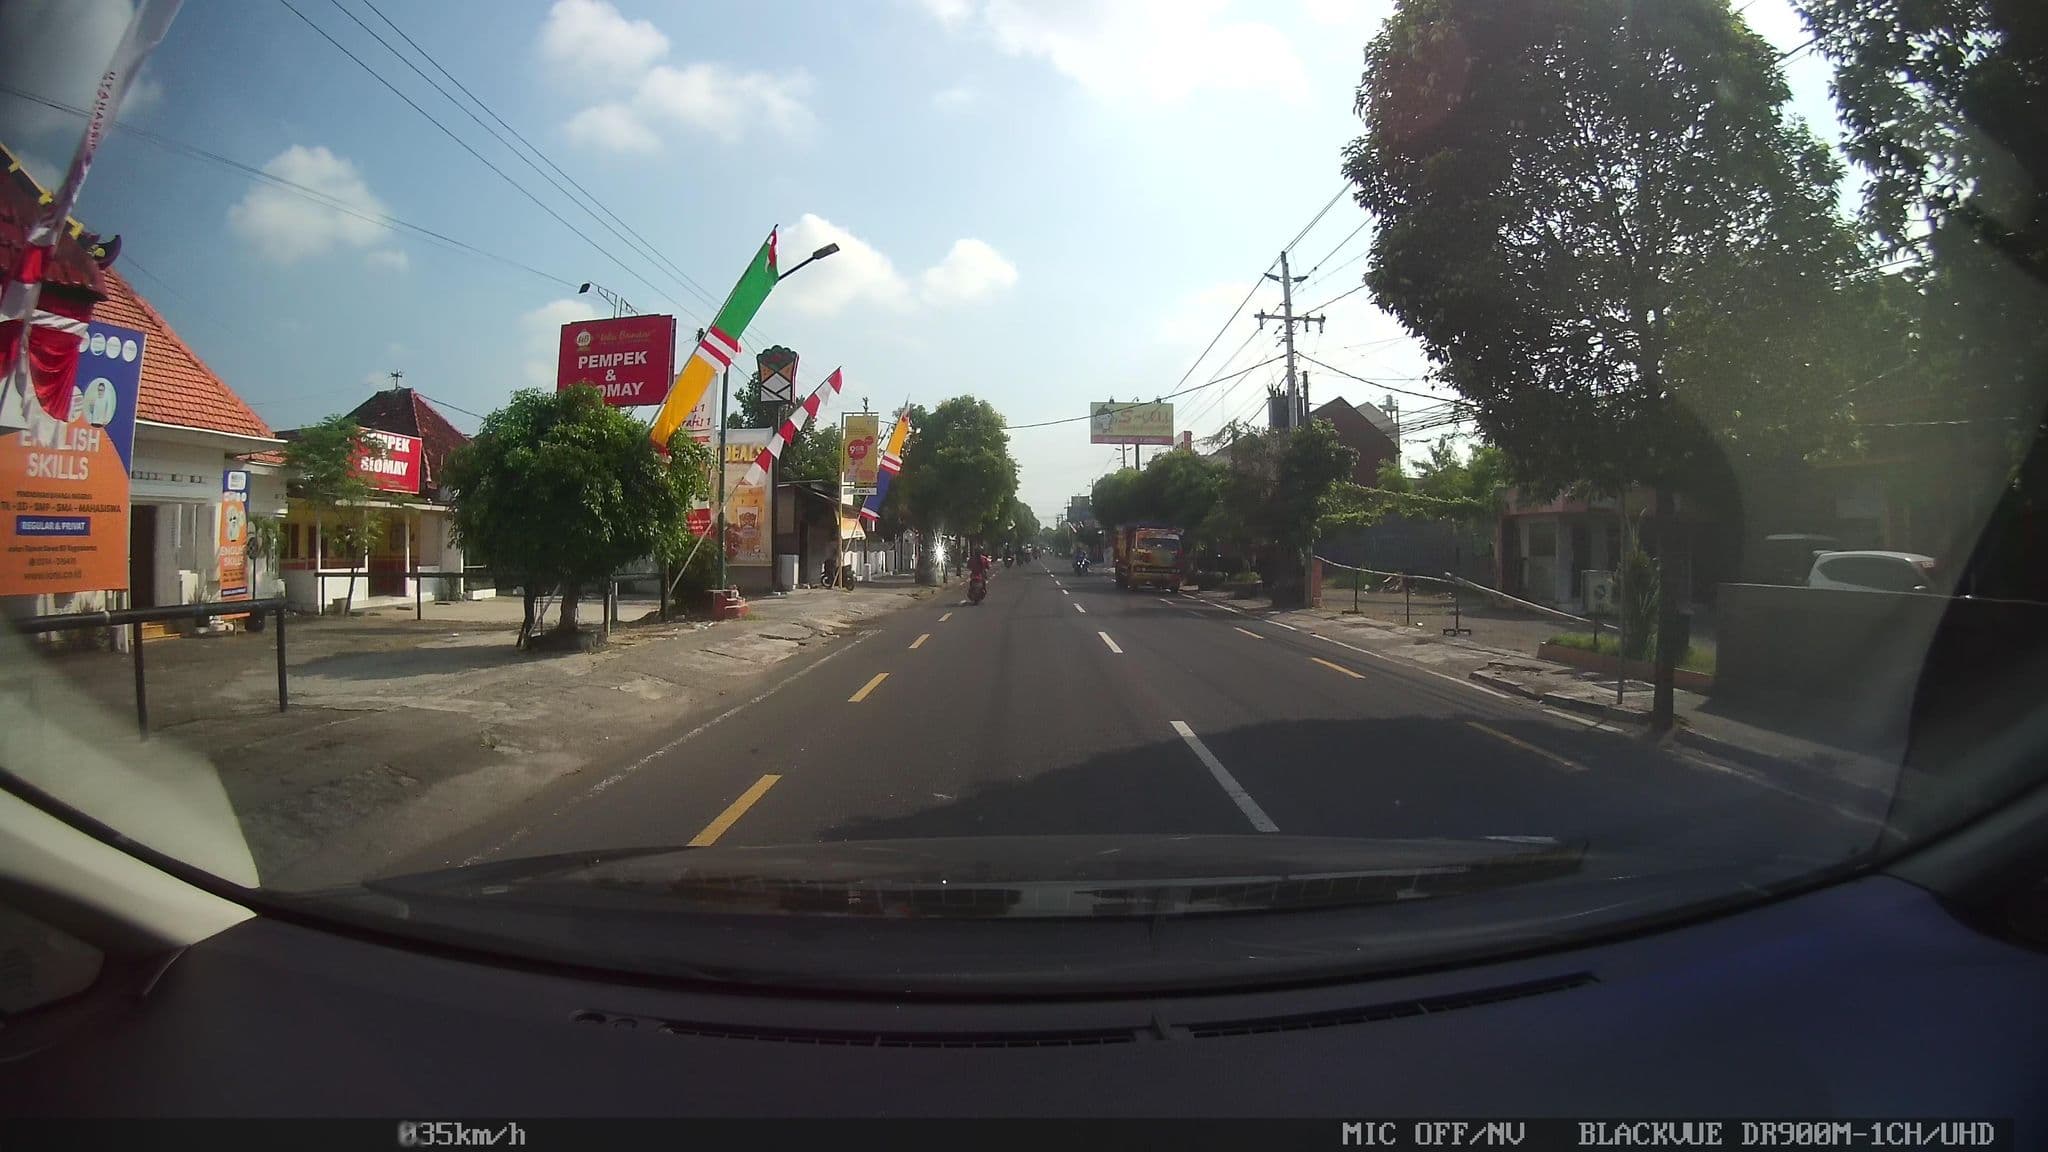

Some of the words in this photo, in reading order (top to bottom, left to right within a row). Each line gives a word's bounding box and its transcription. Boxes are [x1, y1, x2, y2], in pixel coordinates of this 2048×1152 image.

[578, 351, 648, 369] PEMPEK
[605, 369, 616, 382] &
[27, 452, 89, 481] SKILLS
[360, 456, 409, 477] SIOMAY
[22, 521, 54, 530] REGULAR
[62, 522, 86, 530] PRIVAT
